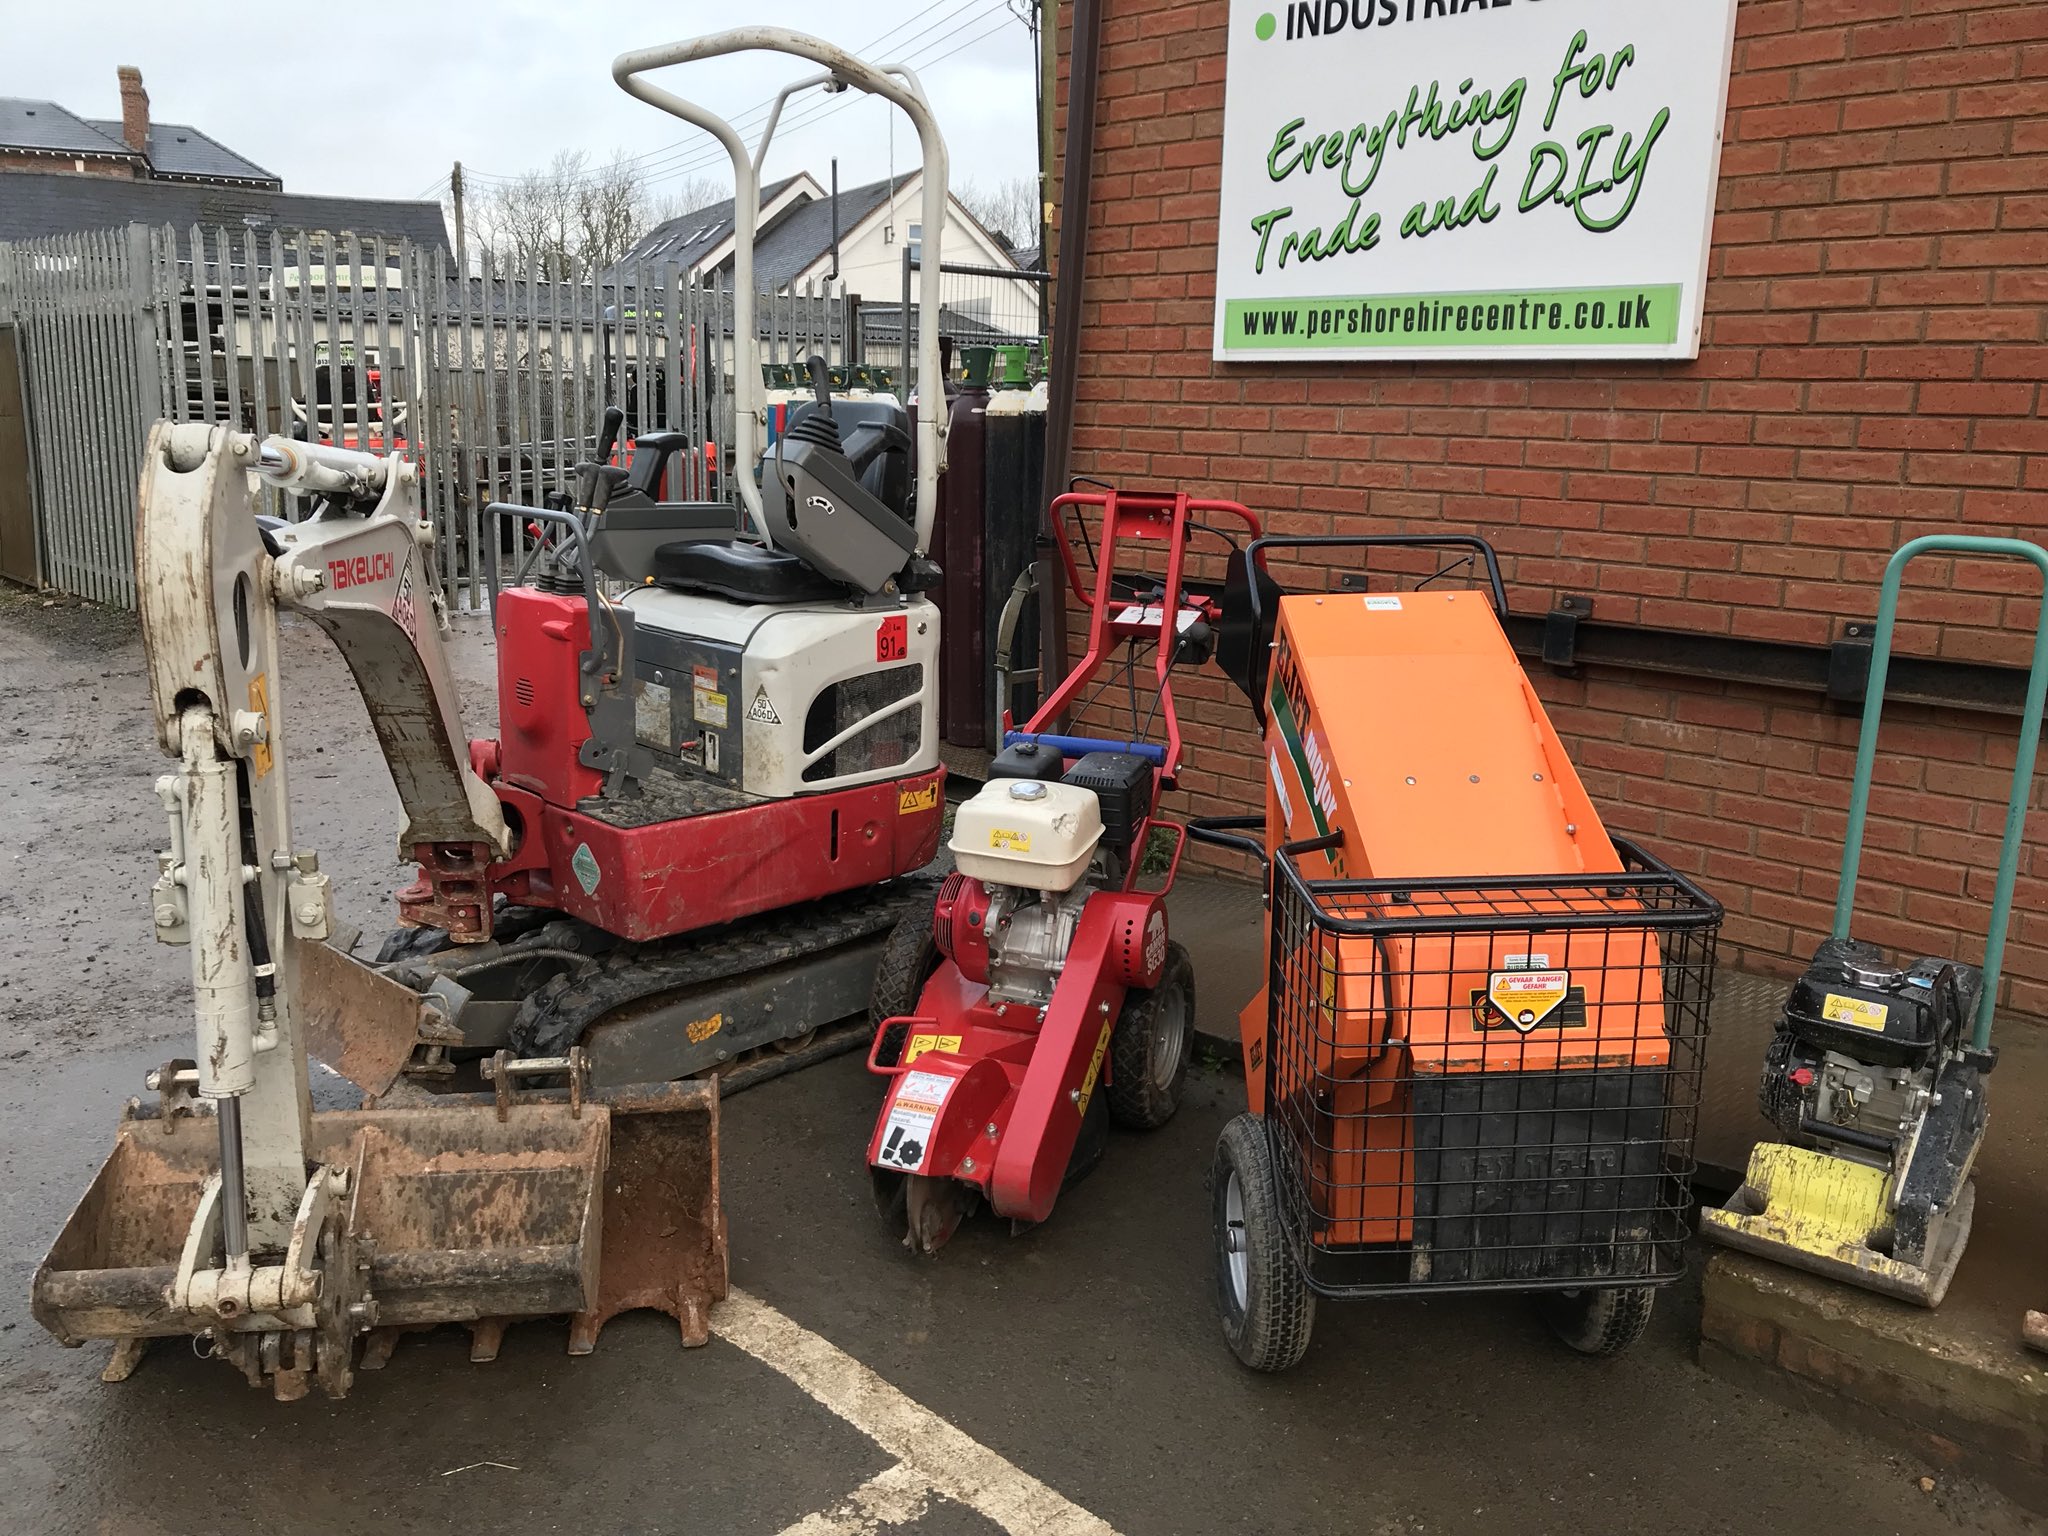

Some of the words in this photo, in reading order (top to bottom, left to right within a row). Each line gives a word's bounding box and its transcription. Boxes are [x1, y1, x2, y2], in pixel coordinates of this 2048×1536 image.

[1266, 77, 1527, 197] Everything
[1544, 29, 1634, 130] for
[1251, 197, 1380, 274] Trade
[1400, 164, 1501, 238] and
[1517, 106, 1671, 233] D.I.Y
[1243, 293, 1653, 340] www.pershorehirecentre.co.uk
[328, 552, 395, 590] TAKEUCHI
[880, 636, 896, 659] 91
[1304, 728, 1337, 822] major
[903, 1101, 938, 1113] WARNING
